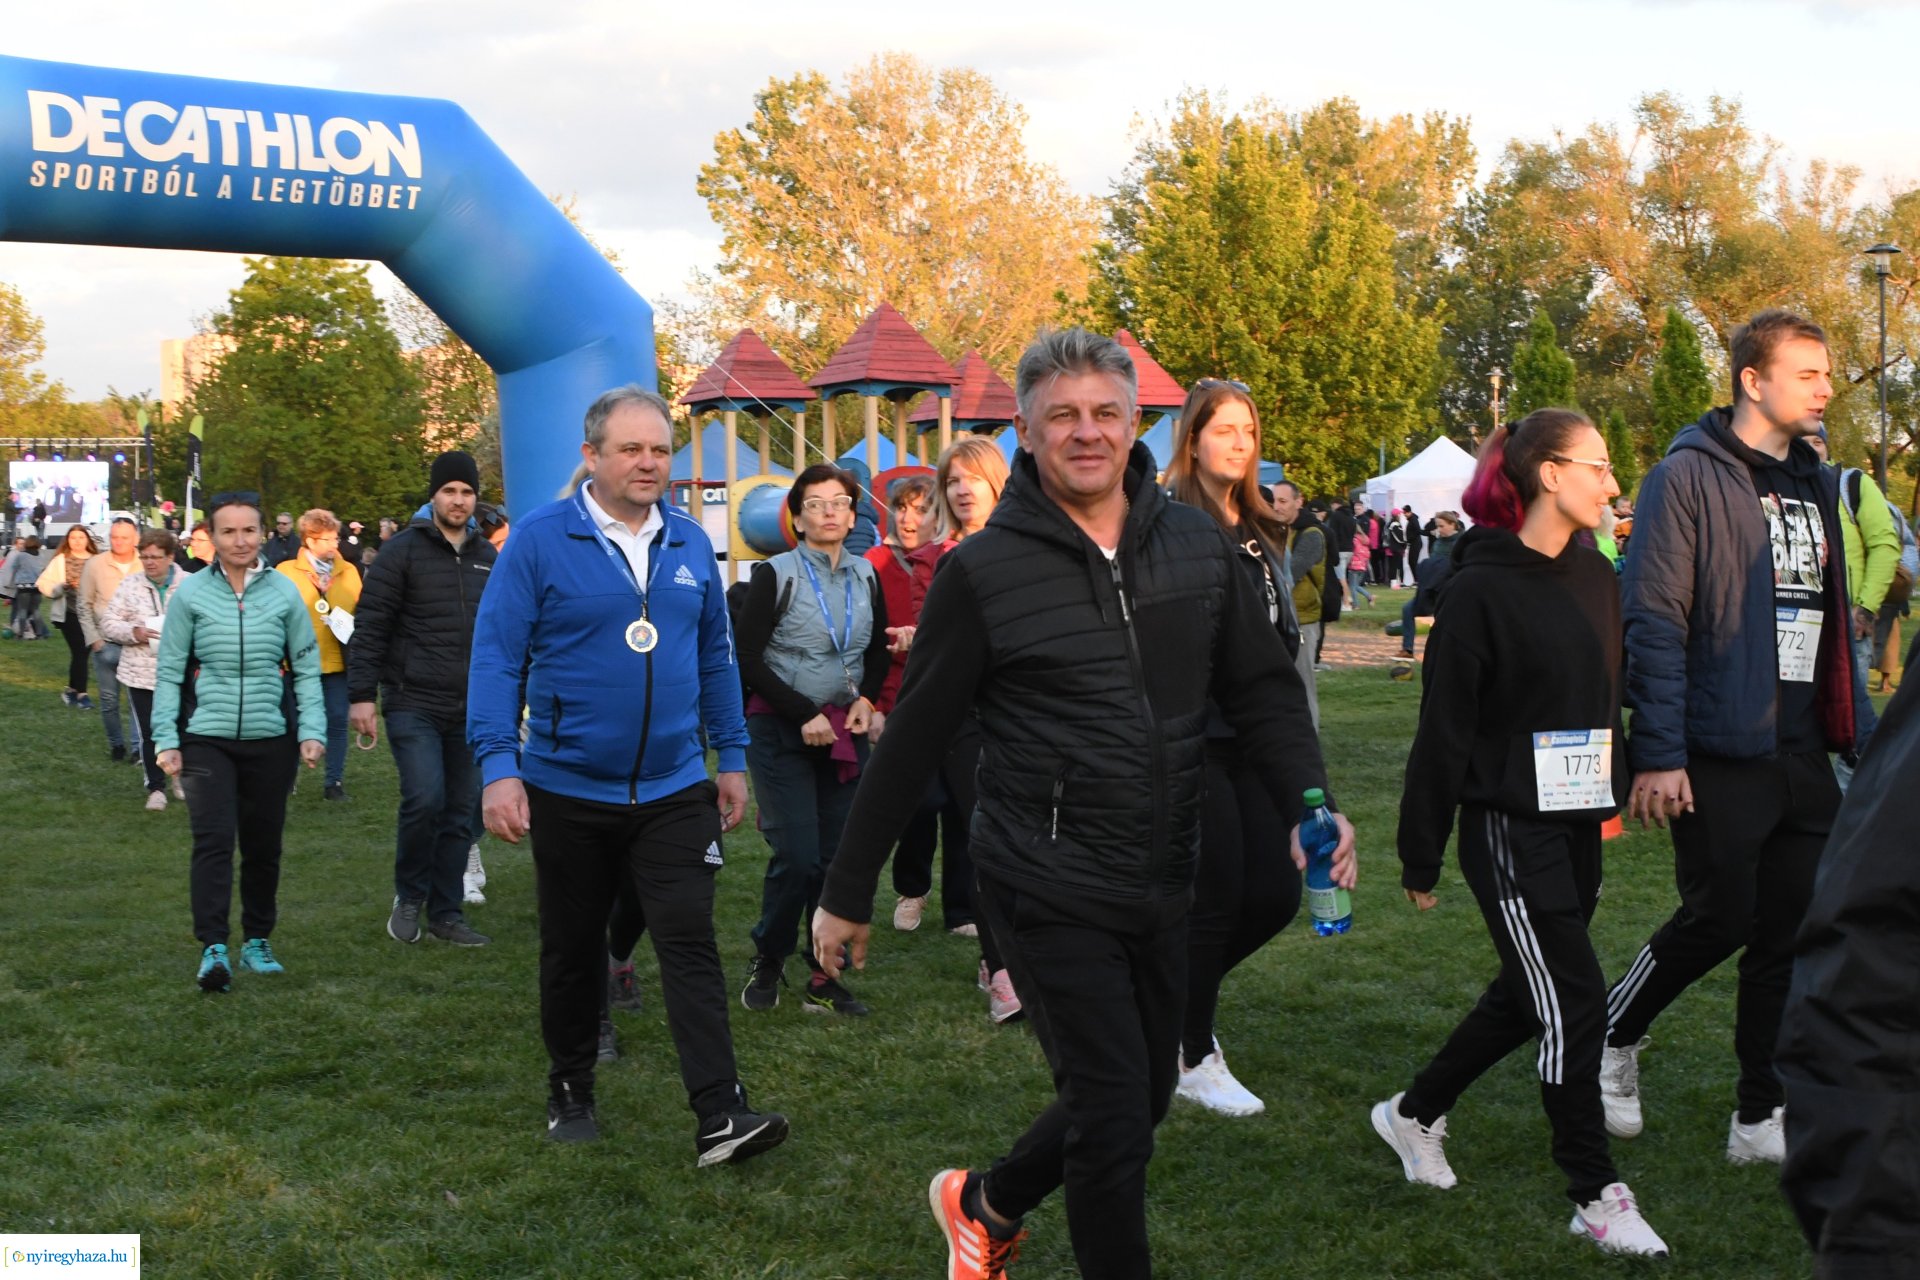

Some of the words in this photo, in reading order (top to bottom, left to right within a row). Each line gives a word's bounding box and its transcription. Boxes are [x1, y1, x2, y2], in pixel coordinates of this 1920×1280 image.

[27, 89, 422, 179] DECATHLON
[29, 159, 199, 198] SPORTBÓL
[216, 174, 232, 199] A
[252, 175, 422, 210] LEGTÖBBET
[1775, 590, 1793, 599] UMMER
[1793, 591, 1810, 600] CHILL
[1777, 629, 1805, 650] 772
[1563, 753, 1602, 776] 1773
